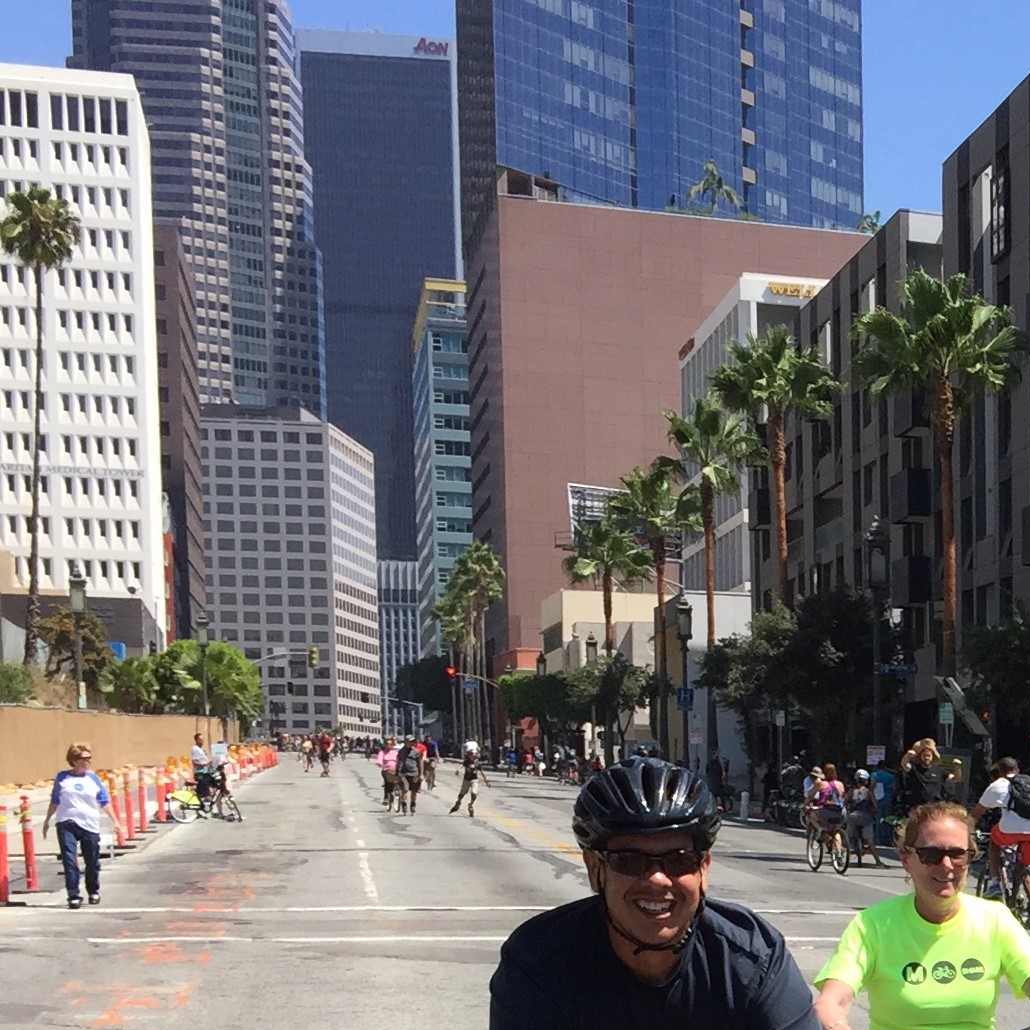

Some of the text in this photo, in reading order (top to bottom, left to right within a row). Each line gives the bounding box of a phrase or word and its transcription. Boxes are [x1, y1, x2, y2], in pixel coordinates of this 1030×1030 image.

[46, 466, 100, 476] MEDICAL
[104, 469, 145, 478] TOWER
[906, 965, 924, 982] M
